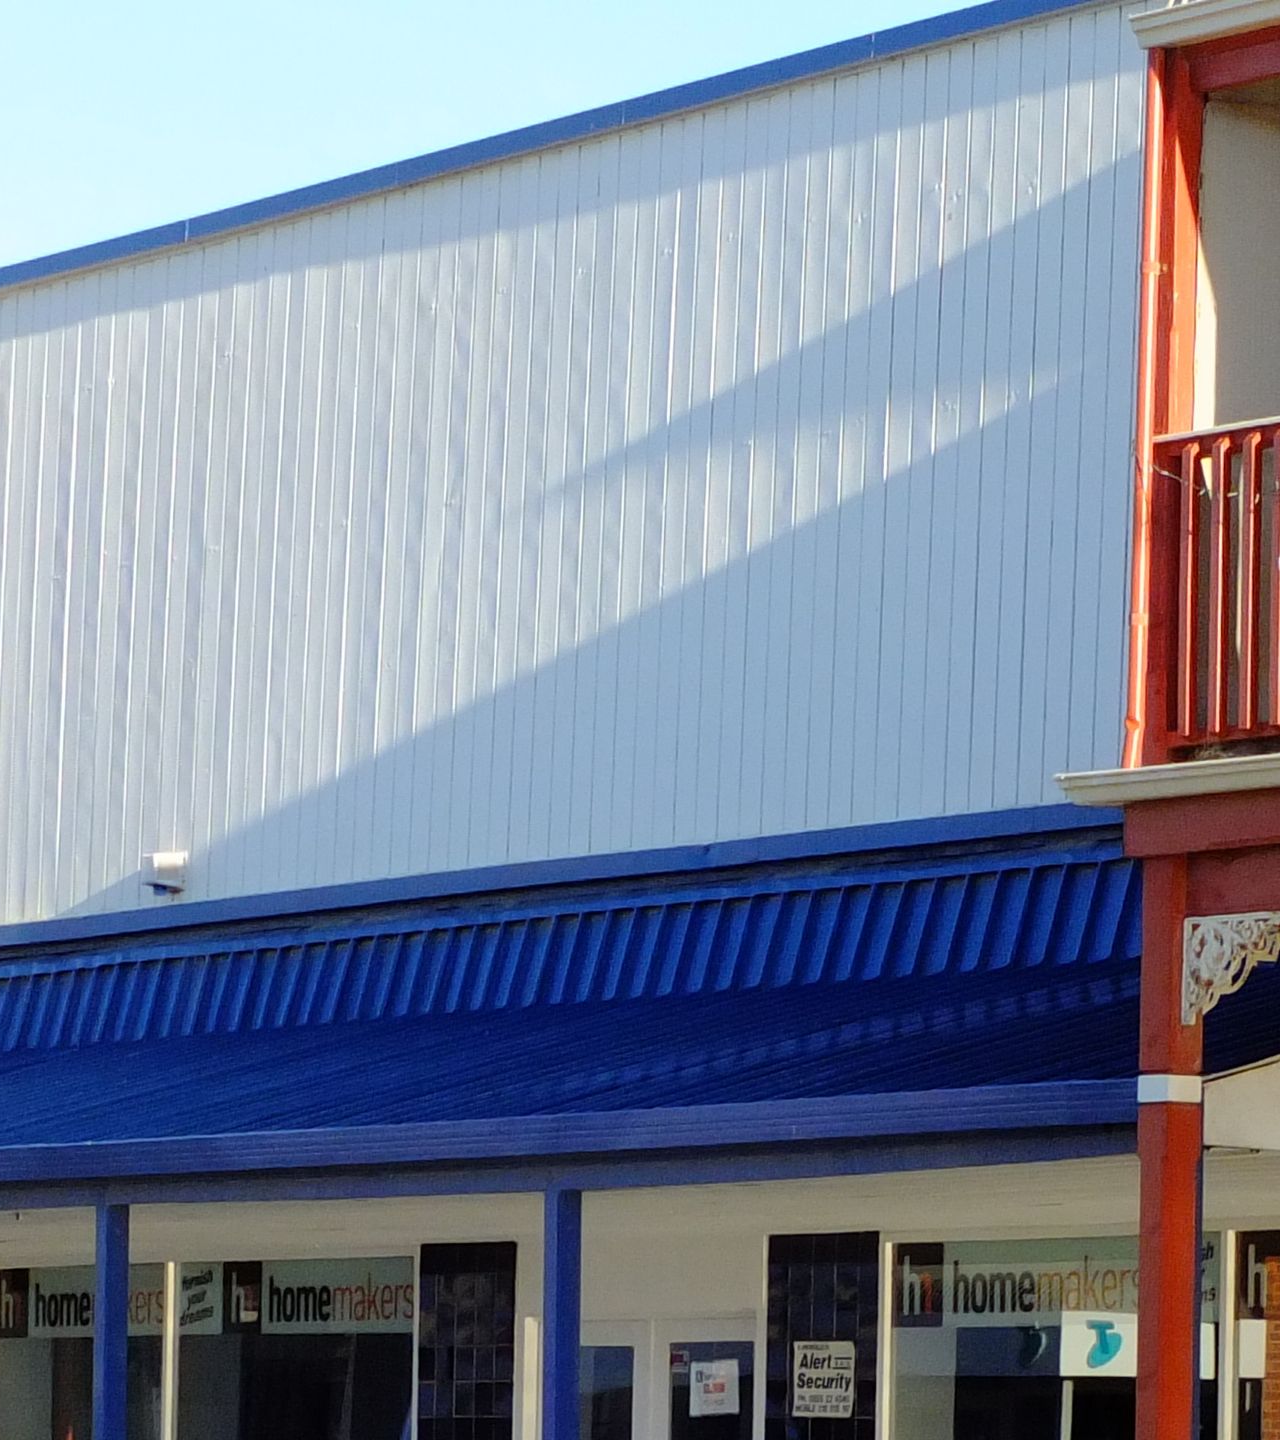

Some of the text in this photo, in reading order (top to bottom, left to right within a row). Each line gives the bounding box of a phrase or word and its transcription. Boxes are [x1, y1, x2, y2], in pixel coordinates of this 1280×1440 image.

[269, 1272, 414, 1323] homemakers
[799, 1352, 832, 1370] Alert
[796, 1372, 852, 1393] Security
